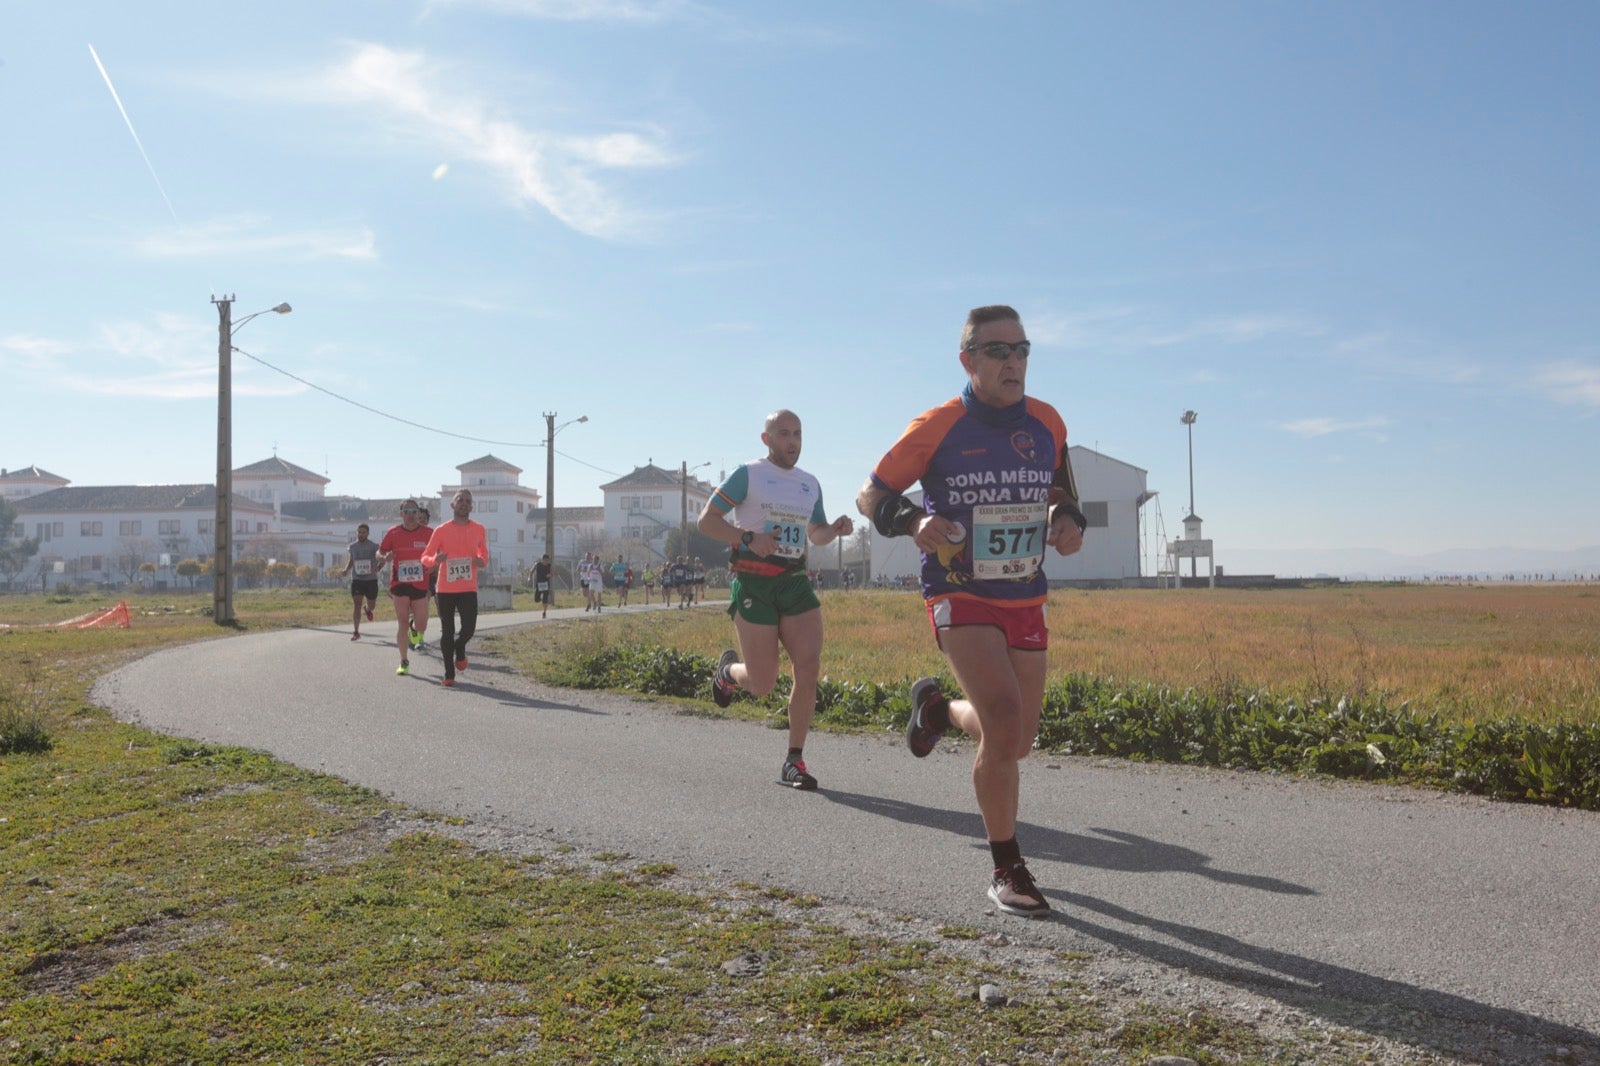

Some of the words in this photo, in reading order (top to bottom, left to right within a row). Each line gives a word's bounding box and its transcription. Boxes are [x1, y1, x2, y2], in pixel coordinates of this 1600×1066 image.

[945, 471, 997, 487] DONA
[948, 488, 1011, 505] DONA
[988, 527, 1038, 555] 577
[402, 566, 420, 575] 102
[449, 565, 471, 575] 3135
